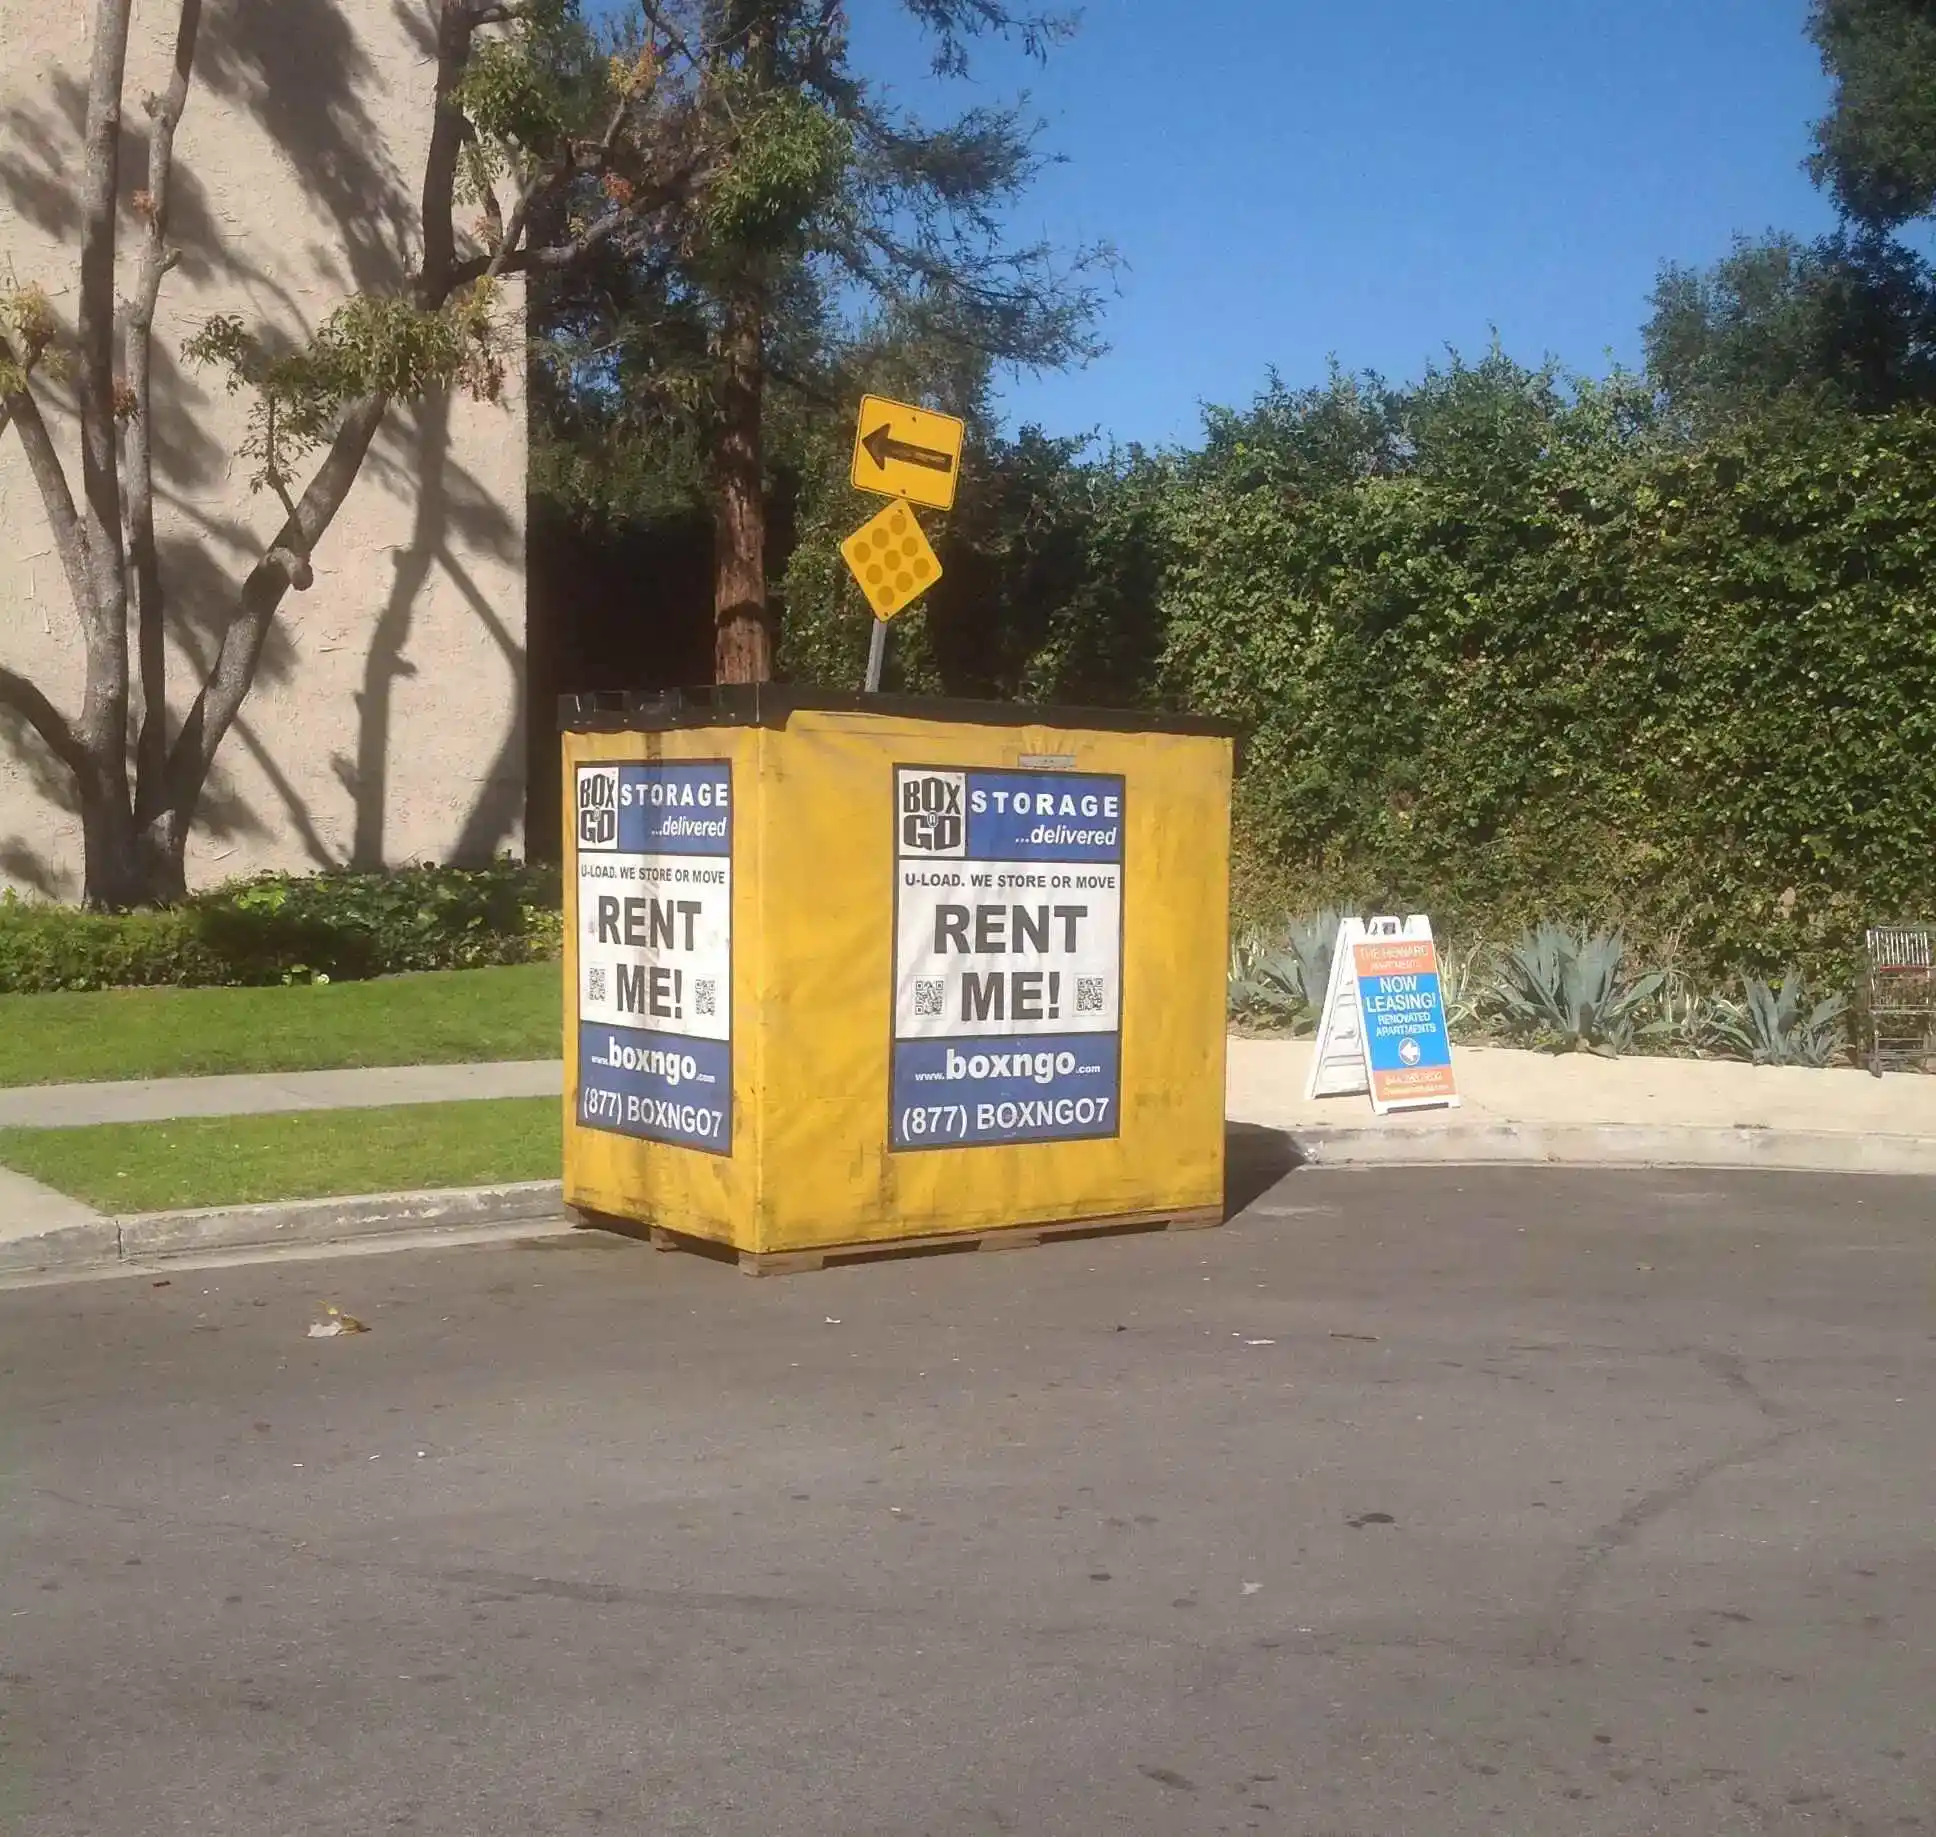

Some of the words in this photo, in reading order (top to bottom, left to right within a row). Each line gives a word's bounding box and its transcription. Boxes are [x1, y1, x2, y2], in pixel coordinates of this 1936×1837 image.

[580, 774, 615, 808] BOX
[620, 783, 728, 807] STORAGE
[903, 777, 961, 815] BOX
[971, 790, 1119, 818] STORAGE
[580, 809, 616, 843] GO
[651, 816, 727, 836] ...delivered
[903, 814, 962, 851] GO
[1015, 824, 1118, 846] ...delivered
[581, 864, 617, 879] U-LOAD.
[620, 866, 636, 880] WE
[638, 867, 672, 882] STORE
[674, 870, 690, 882] OR
[692, 871, 725, 884] MOVE
[905, 873, 965, 887] U-LOAD.
[971, 874, 993, 887] WE
[997, 874, 1046, 888] STORE
[1051, 875, 1071, 888] OR
[1075, 876, 1115, 889] MOVE
[598, 895, 702, 951] RENT
[933, 904, 1088, 954] RENT
[616, 963, 682, 1019] ME!
[961, 971, 1061, 1022] ME!
[1380, 975, 1417, 993] NOW
[1366, 992, 1437, 1013] LEASING!
[1377, 1011, 1431, 1025] RENOVATED
[1376, 1023, 1437, 1036] APARTMENTS
[915, 1048, 1101, 1084] www.boxngo.com
[583, 1087, 623, 1124] (877)
[627, 1096, 723, 1138] BOXNGO7
[902, 1105, 968, 1141] (877)
[976, 1097, 1110, 1130] BOXNGO7
